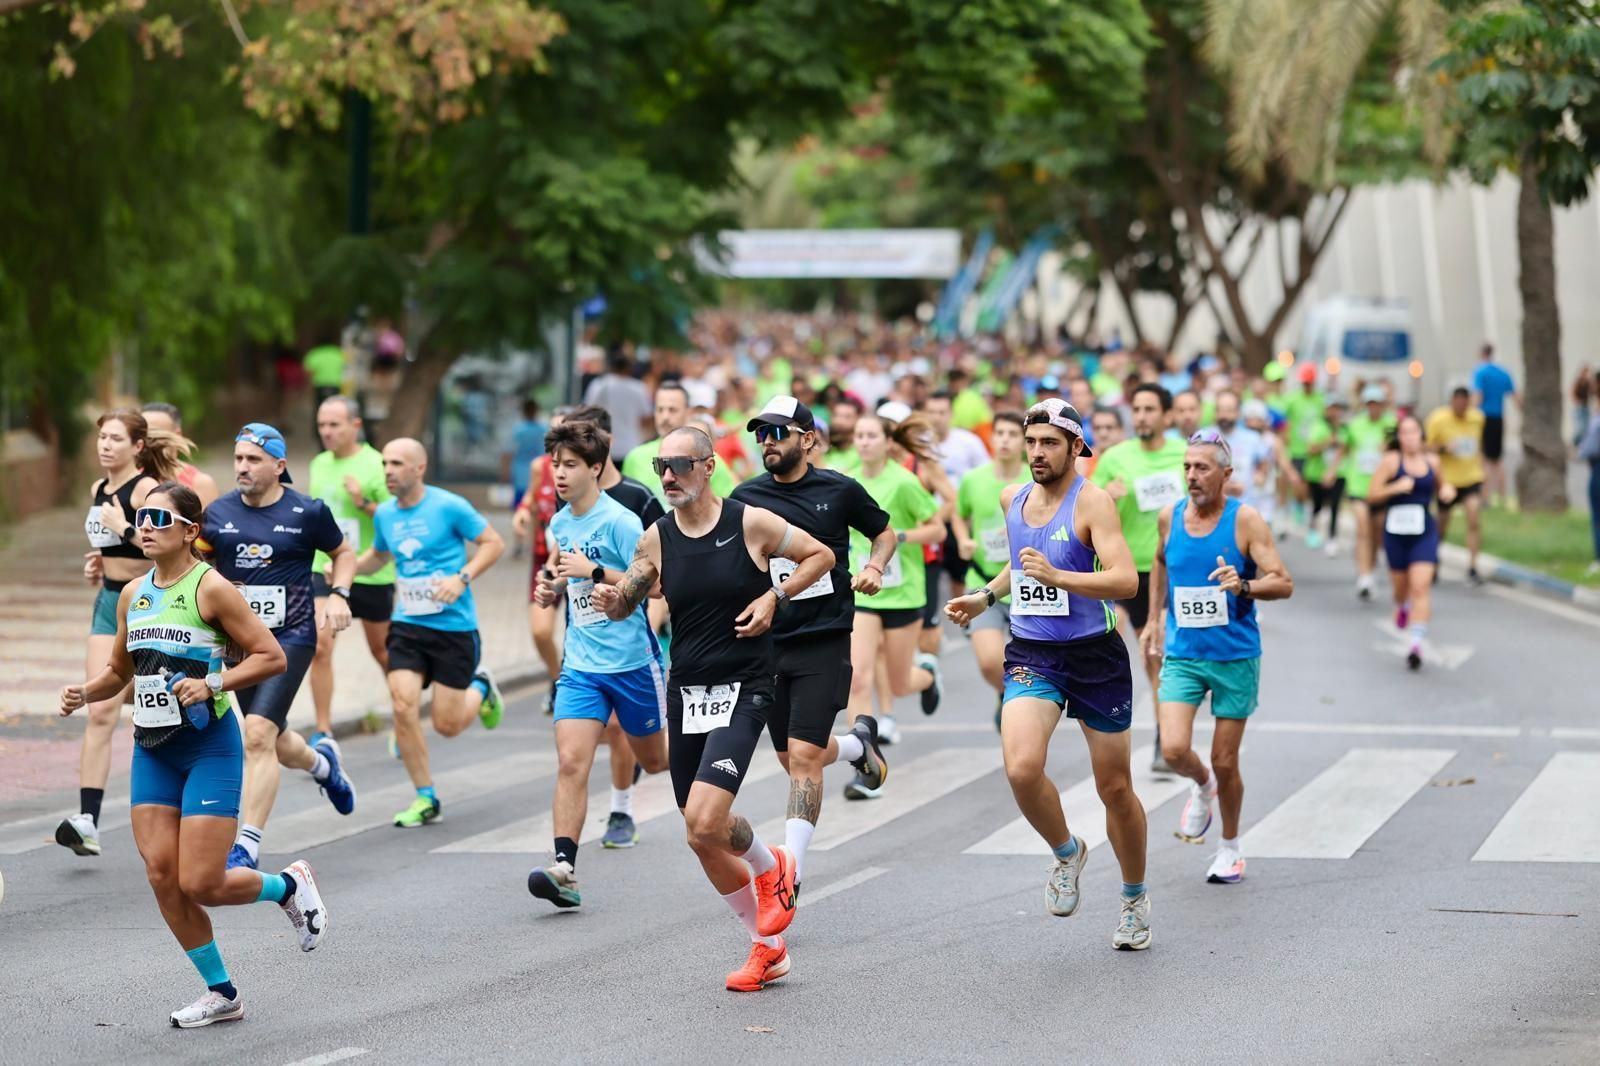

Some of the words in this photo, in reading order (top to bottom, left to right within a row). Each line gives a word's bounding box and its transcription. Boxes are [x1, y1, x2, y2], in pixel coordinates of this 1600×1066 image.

[1020, 585, 1058, 601] 549
[1181, 600, 1218, 615] 583
[127, 627, 192, 644] RREMOLINOS
[138, 692, 169, 708] 126
[688, 700, 731, 717] 1183
